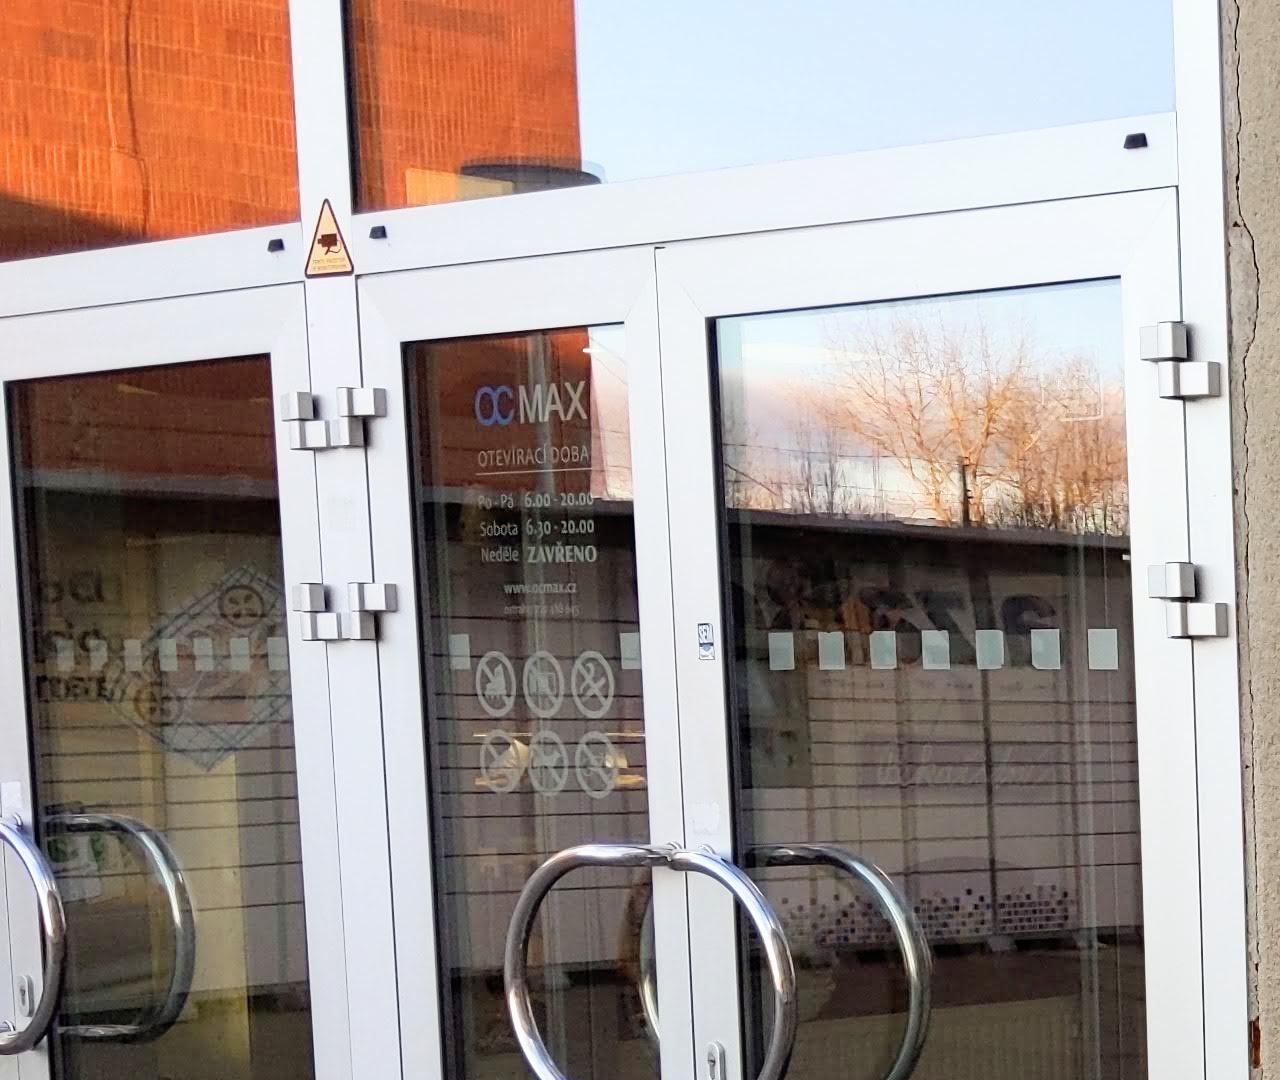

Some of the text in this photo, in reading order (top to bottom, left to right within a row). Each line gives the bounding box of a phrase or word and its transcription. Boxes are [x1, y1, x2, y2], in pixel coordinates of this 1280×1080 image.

[518, 381, 588, 424] MAX
[551, 445, 589, 464] DOBA
[524, 491, 551, 508] 6.00
[560, 492, 594, 506] 20.00
[480, 520, 519, 537] Sobota
[526, 518, 551, 538] 6.30
[560, 519, 595, 534] 20.00
[481, 541, 598, 563] Neděle ZAVŘENO
